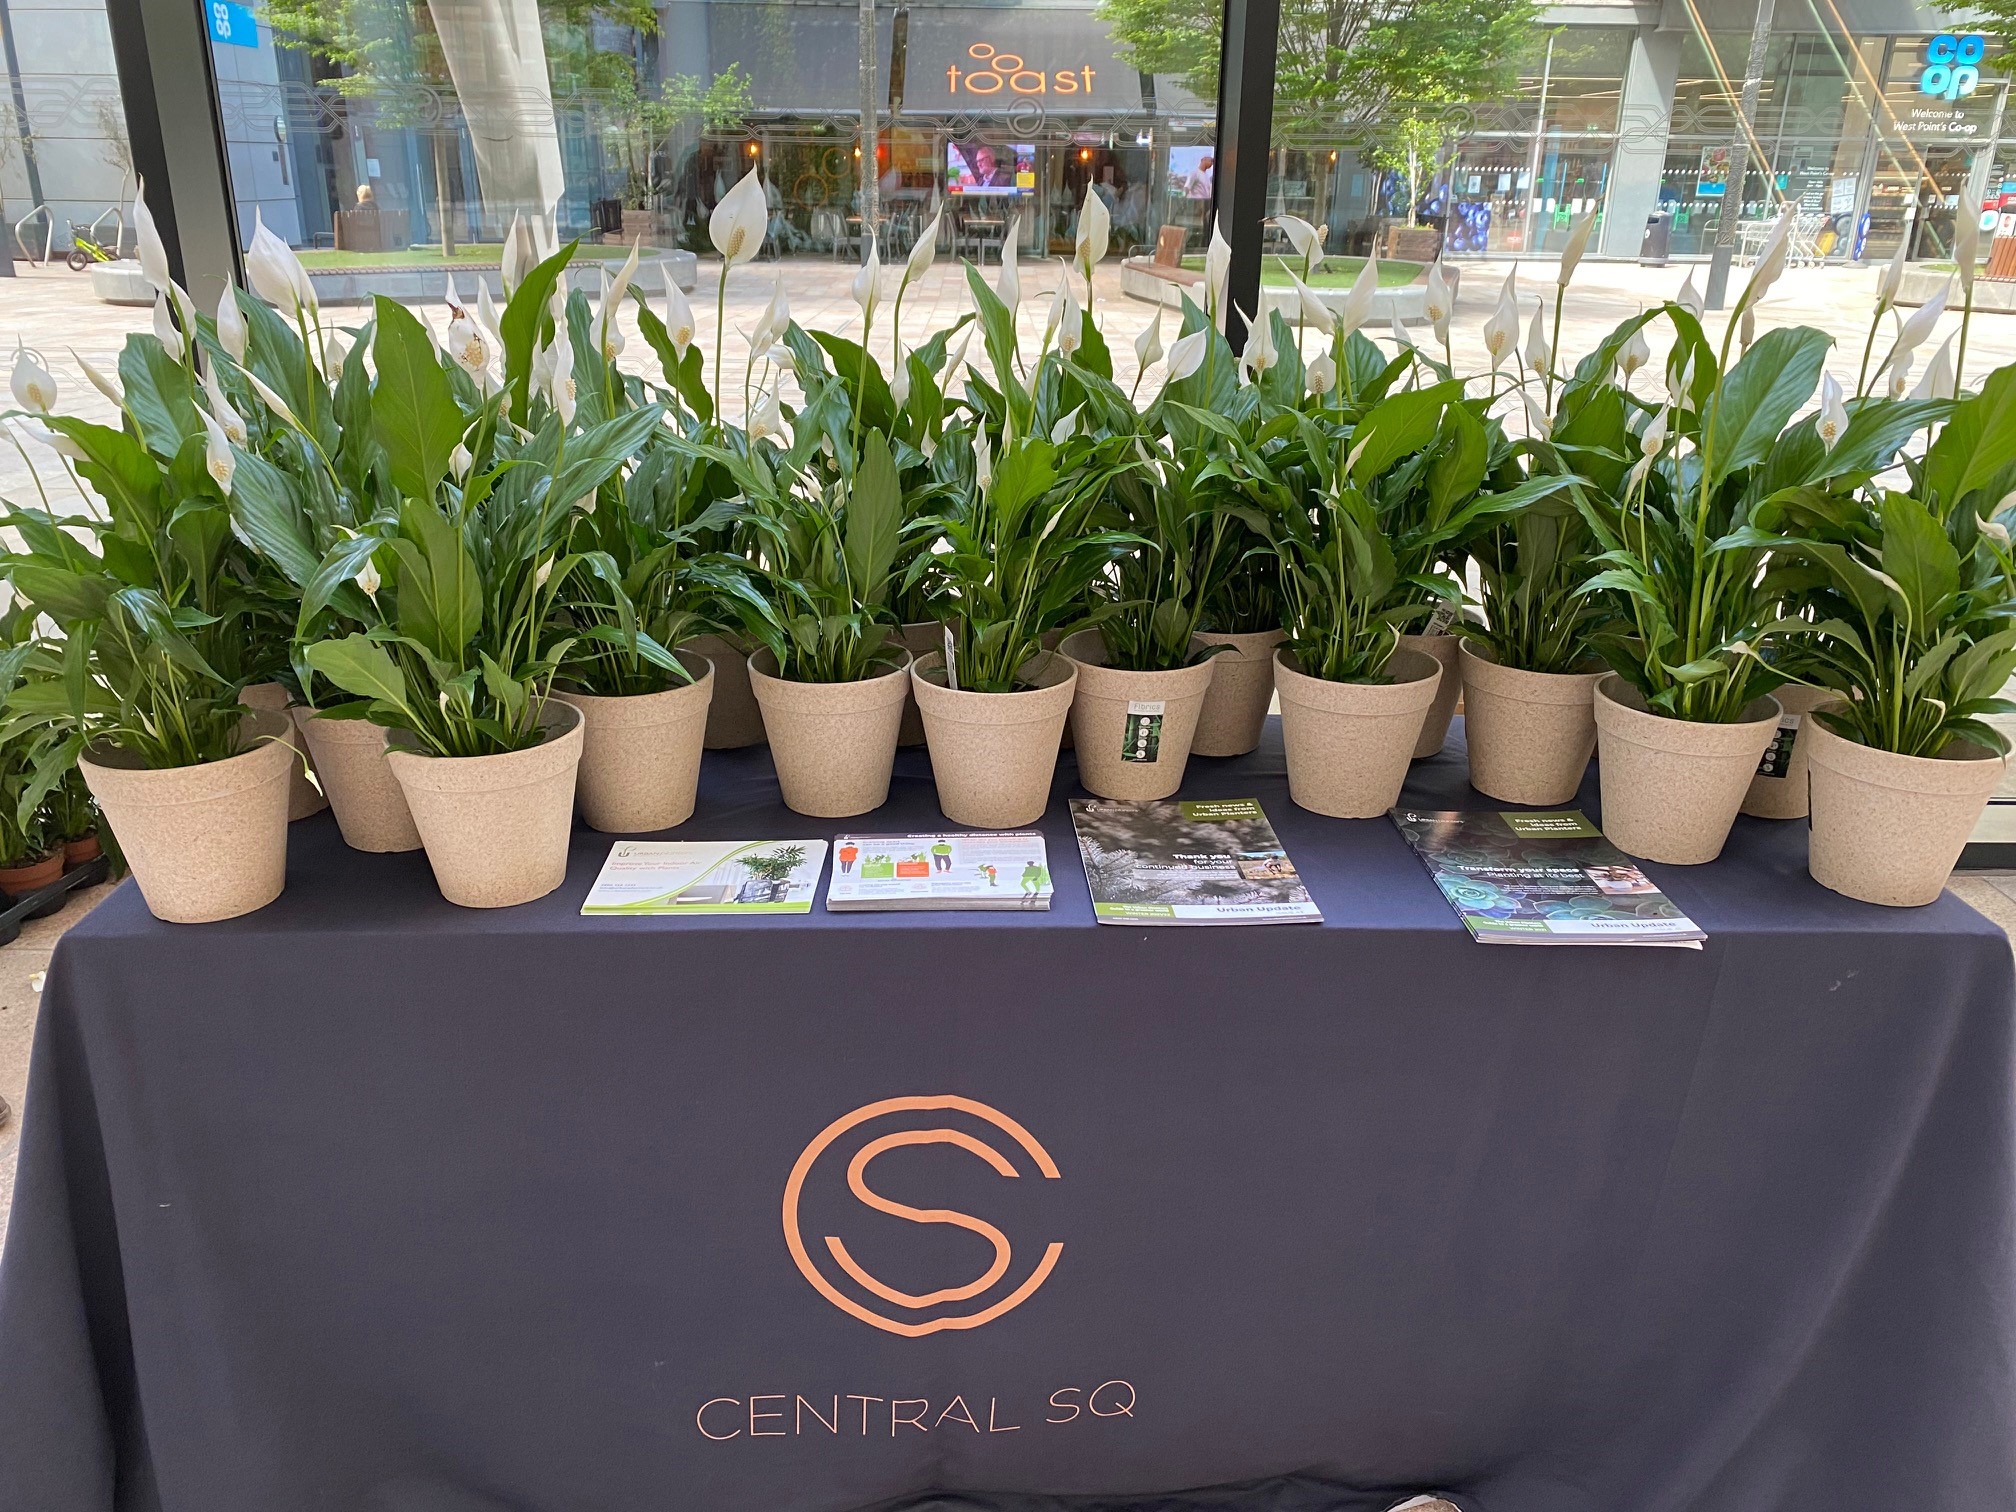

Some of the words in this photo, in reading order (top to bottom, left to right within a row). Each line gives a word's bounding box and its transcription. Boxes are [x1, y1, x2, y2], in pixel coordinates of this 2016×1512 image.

[1911, 108, 1953, 119] Welcome
[1954, 109, 1965, 119] to
[1893, 121, 1916, 131] West
[1917, 121, 1947, 131] Point's
[1948, 121, 1978, 134] Co-op
[1457, 865, 1516, 873] Transform
[1631, 921, 1677, 929] Update
[696, 1394, 1021, 1440] CENTRAL
[1045, 1380, 1136, 1424] SQ
